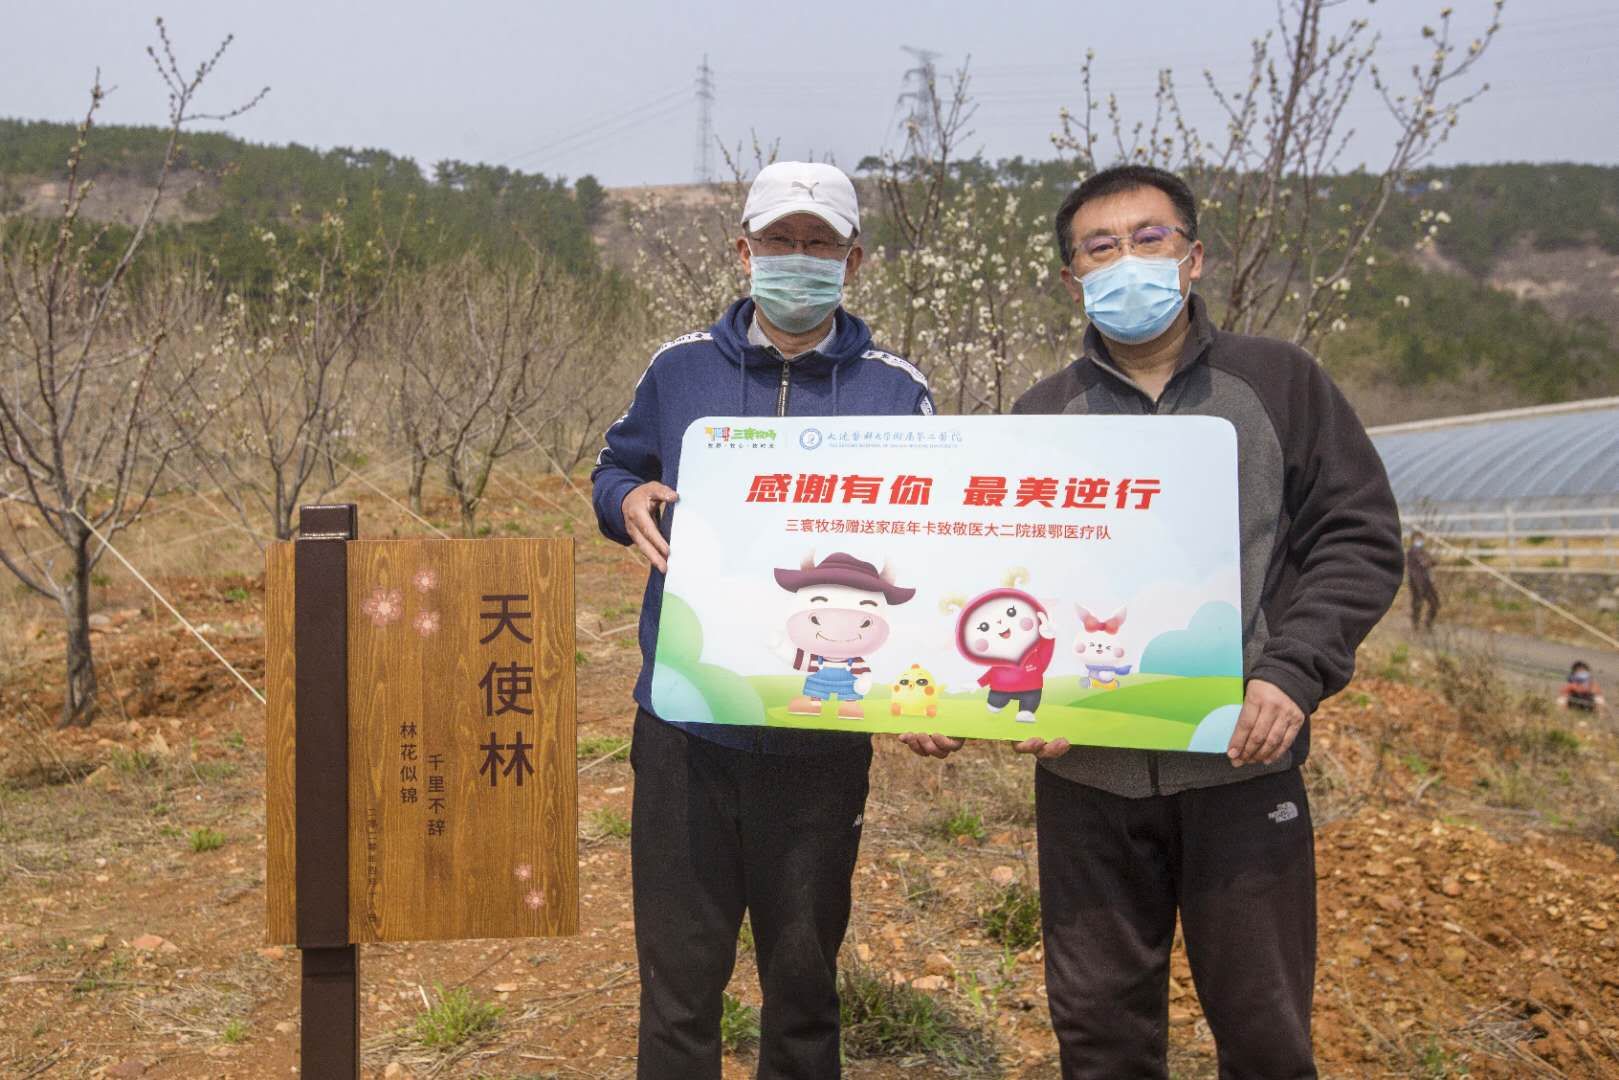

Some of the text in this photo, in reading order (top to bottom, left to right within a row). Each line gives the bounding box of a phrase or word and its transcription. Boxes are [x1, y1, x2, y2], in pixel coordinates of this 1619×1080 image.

[745, 473, 1161, 510] 感谢有你 最美逆行
[785, 518, 1112, 541] 三寰牧场赠送家庭年卡致敬医大二院援鄂医疗队
[479, 594, 535, 787] 天使林
[400, 721, 418, 804] 林花似锦
[427, 753, 446, 837] 千里不辞
